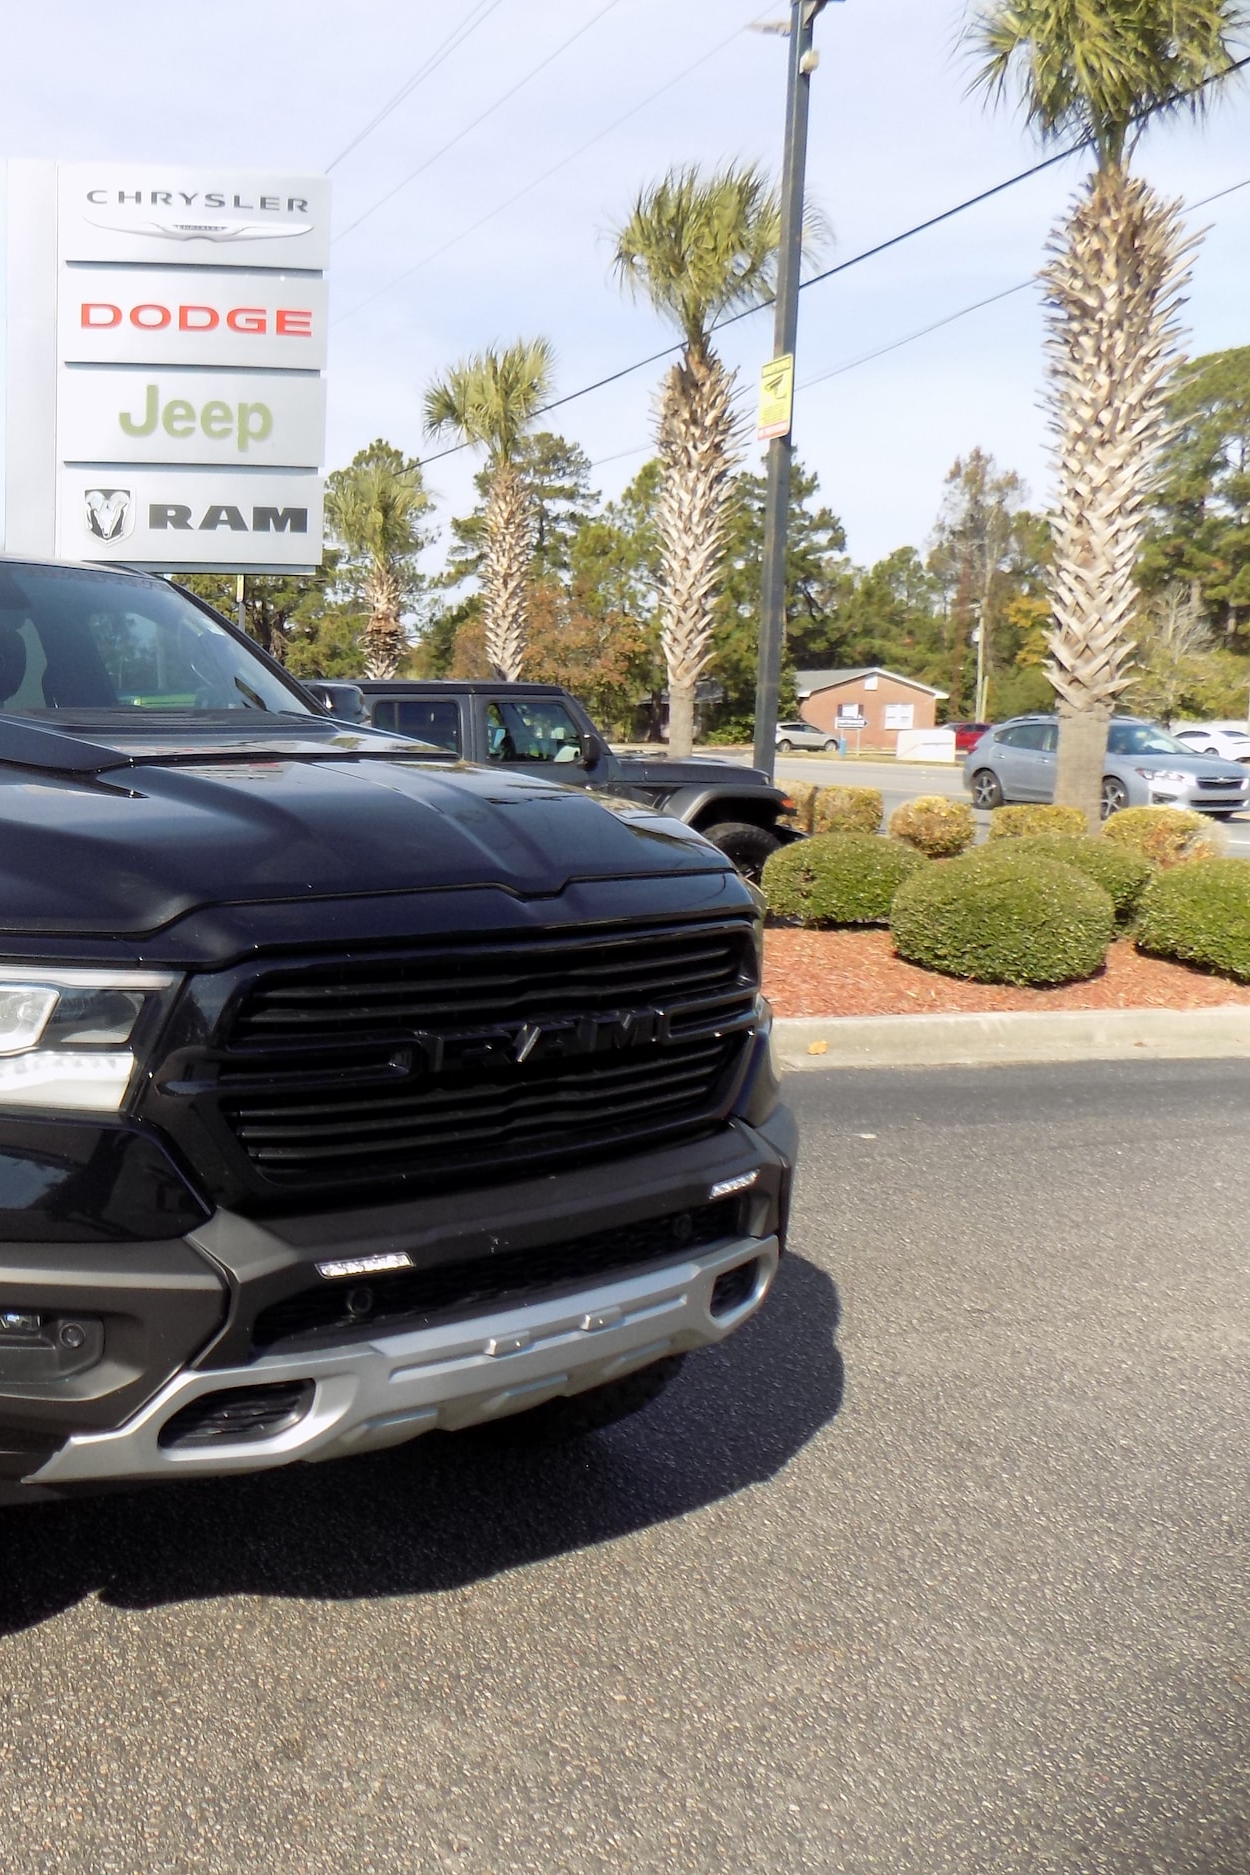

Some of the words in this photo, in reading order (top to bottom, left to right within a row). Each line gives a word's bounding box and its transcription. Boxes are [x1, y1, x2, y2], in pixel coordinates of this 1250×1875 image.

[85, 189, 310, 214] CHRYSLER
[80, 302, 314, 338] DODGE
[118, 384, 274, 453] Jeep
[148, 503, 308, 534] RAM
